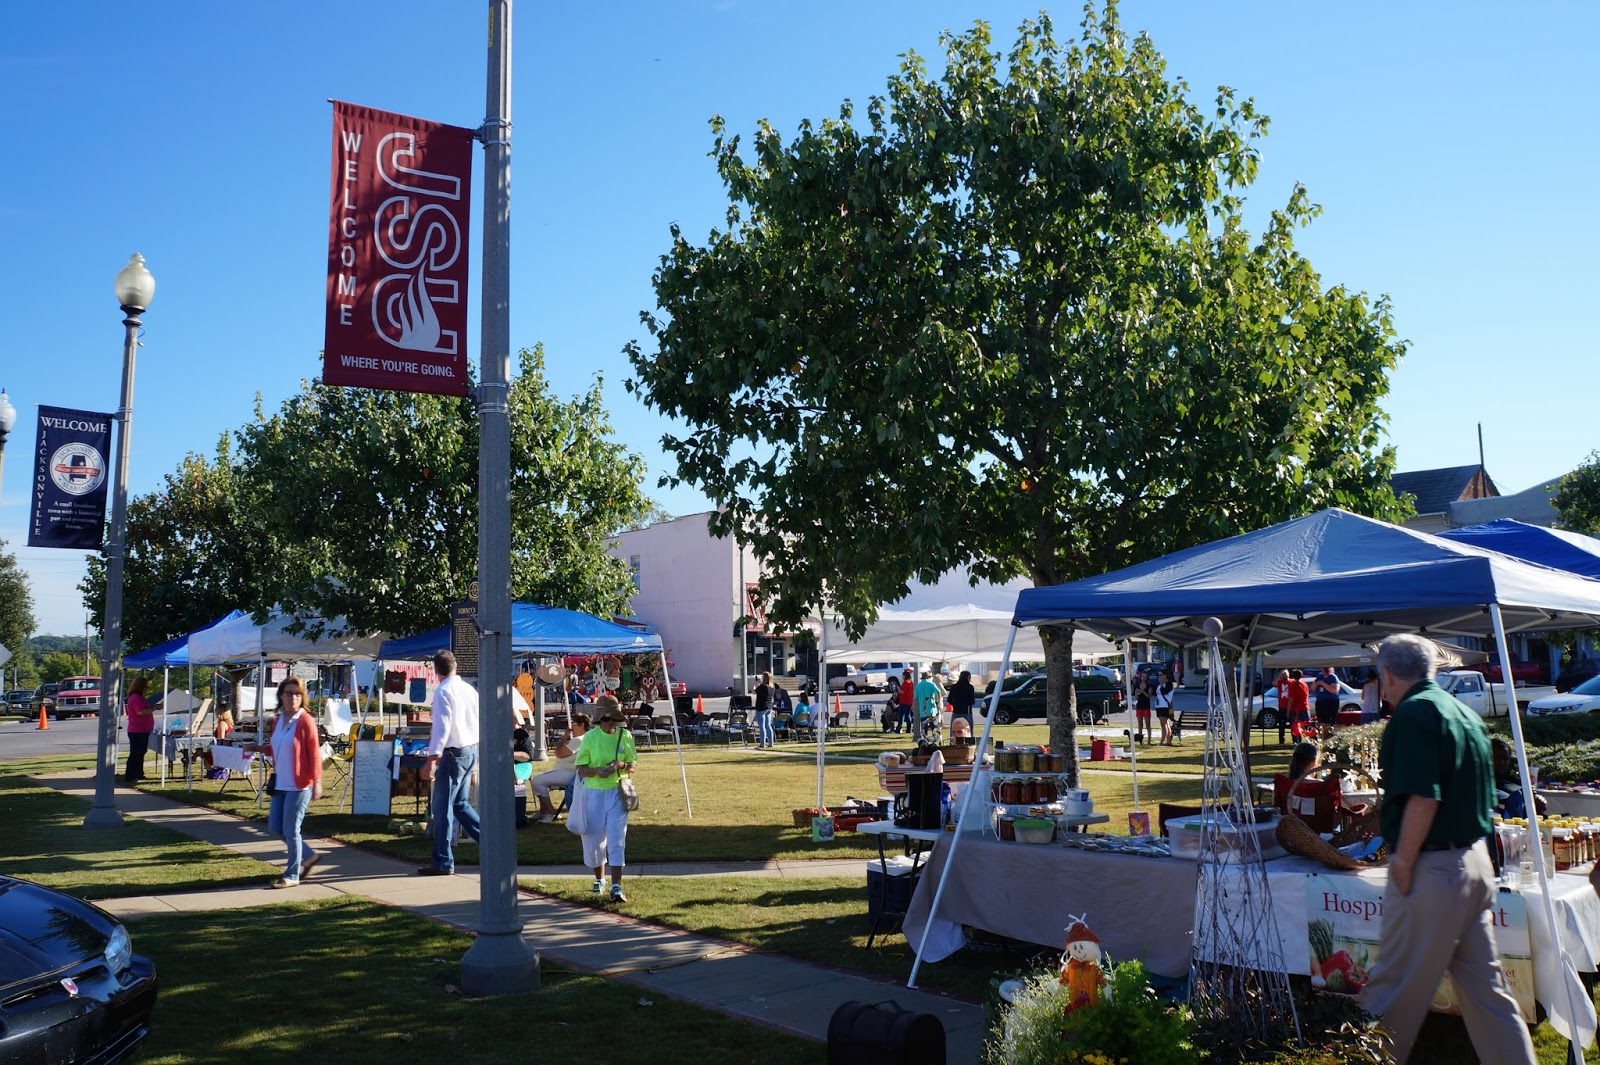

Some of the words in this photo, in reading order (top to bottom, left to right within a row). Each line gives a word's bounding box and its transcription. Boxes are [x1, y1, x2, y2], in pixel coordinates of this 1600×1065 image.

[337, 130, 363, 327] WELCOME
[340, 355, 379, 370] WHERE
[381, 359, 419, 374] YOU'RE
[421, 363, 456, 378] GOING.
[40, 416, 108, 434] WELCOME
[34, 430, 48, 536] JACKSONVILLE
[1322, 892, 1384, 922] Hospi
